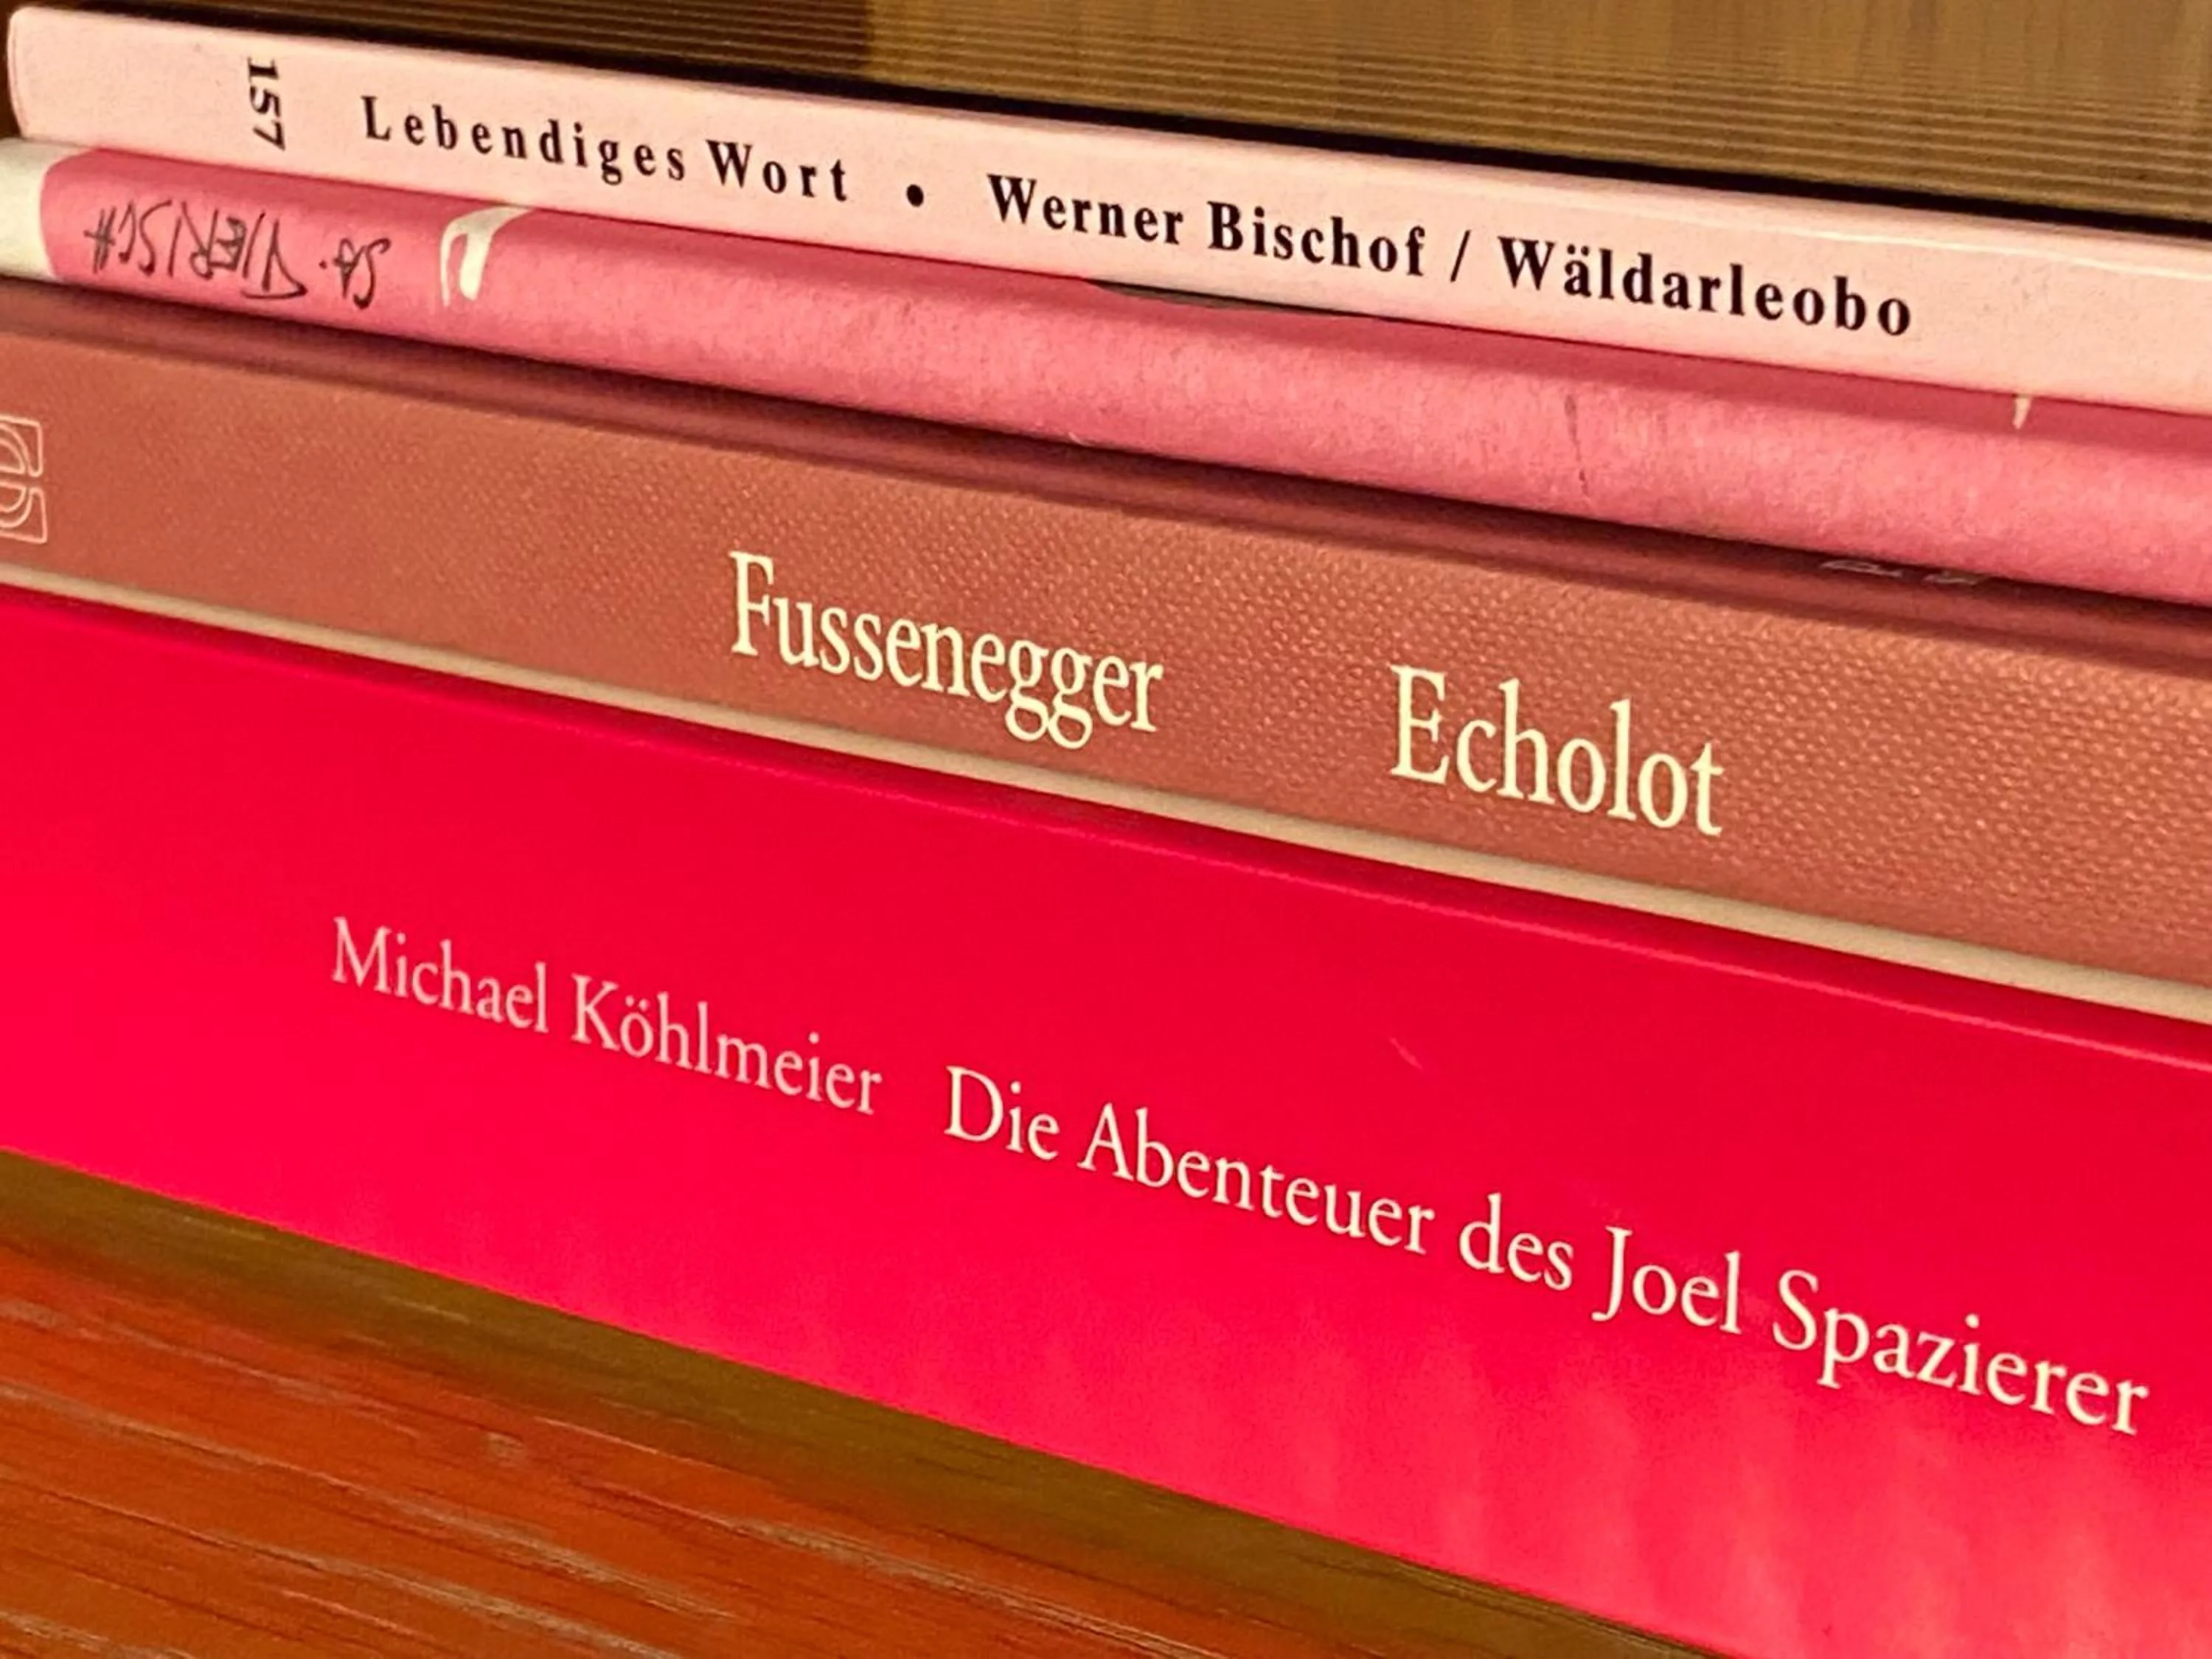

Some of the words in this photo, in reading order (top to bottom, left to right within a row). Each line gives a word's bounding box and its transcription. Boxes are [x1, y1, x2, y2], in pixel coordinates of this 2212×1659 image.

[246, 56, 286, 150] 157
[83, 198, 307, 300] TIERISCH
[360, 95, 686, 186] Lebendiges
[707, 139, 849, 203] Wort
[986, 173, 1183, 246] Werner
[1206, 200, 1425, 276] Bischof
[1450, 229, 1471, 282] /
[1497, 235, 1911, 336] Wäldarleobo
[728, 550, 1164, 749] Fussenegger
[1389, 664, 1724, 838] Echolot
[331, 916, 549, 1034] Michael
[570, 973, 883, 1115] Köhlmeier
[943, 1065, 1060, 1162] Die
[1077, 1102, 1436, 1255] Abenteuer
[1458, 1192, 1575, 1292] des
[1590, 1225, 1742, 1335] Joel
[1772, 1268, 2150, 1436] Spazierer
